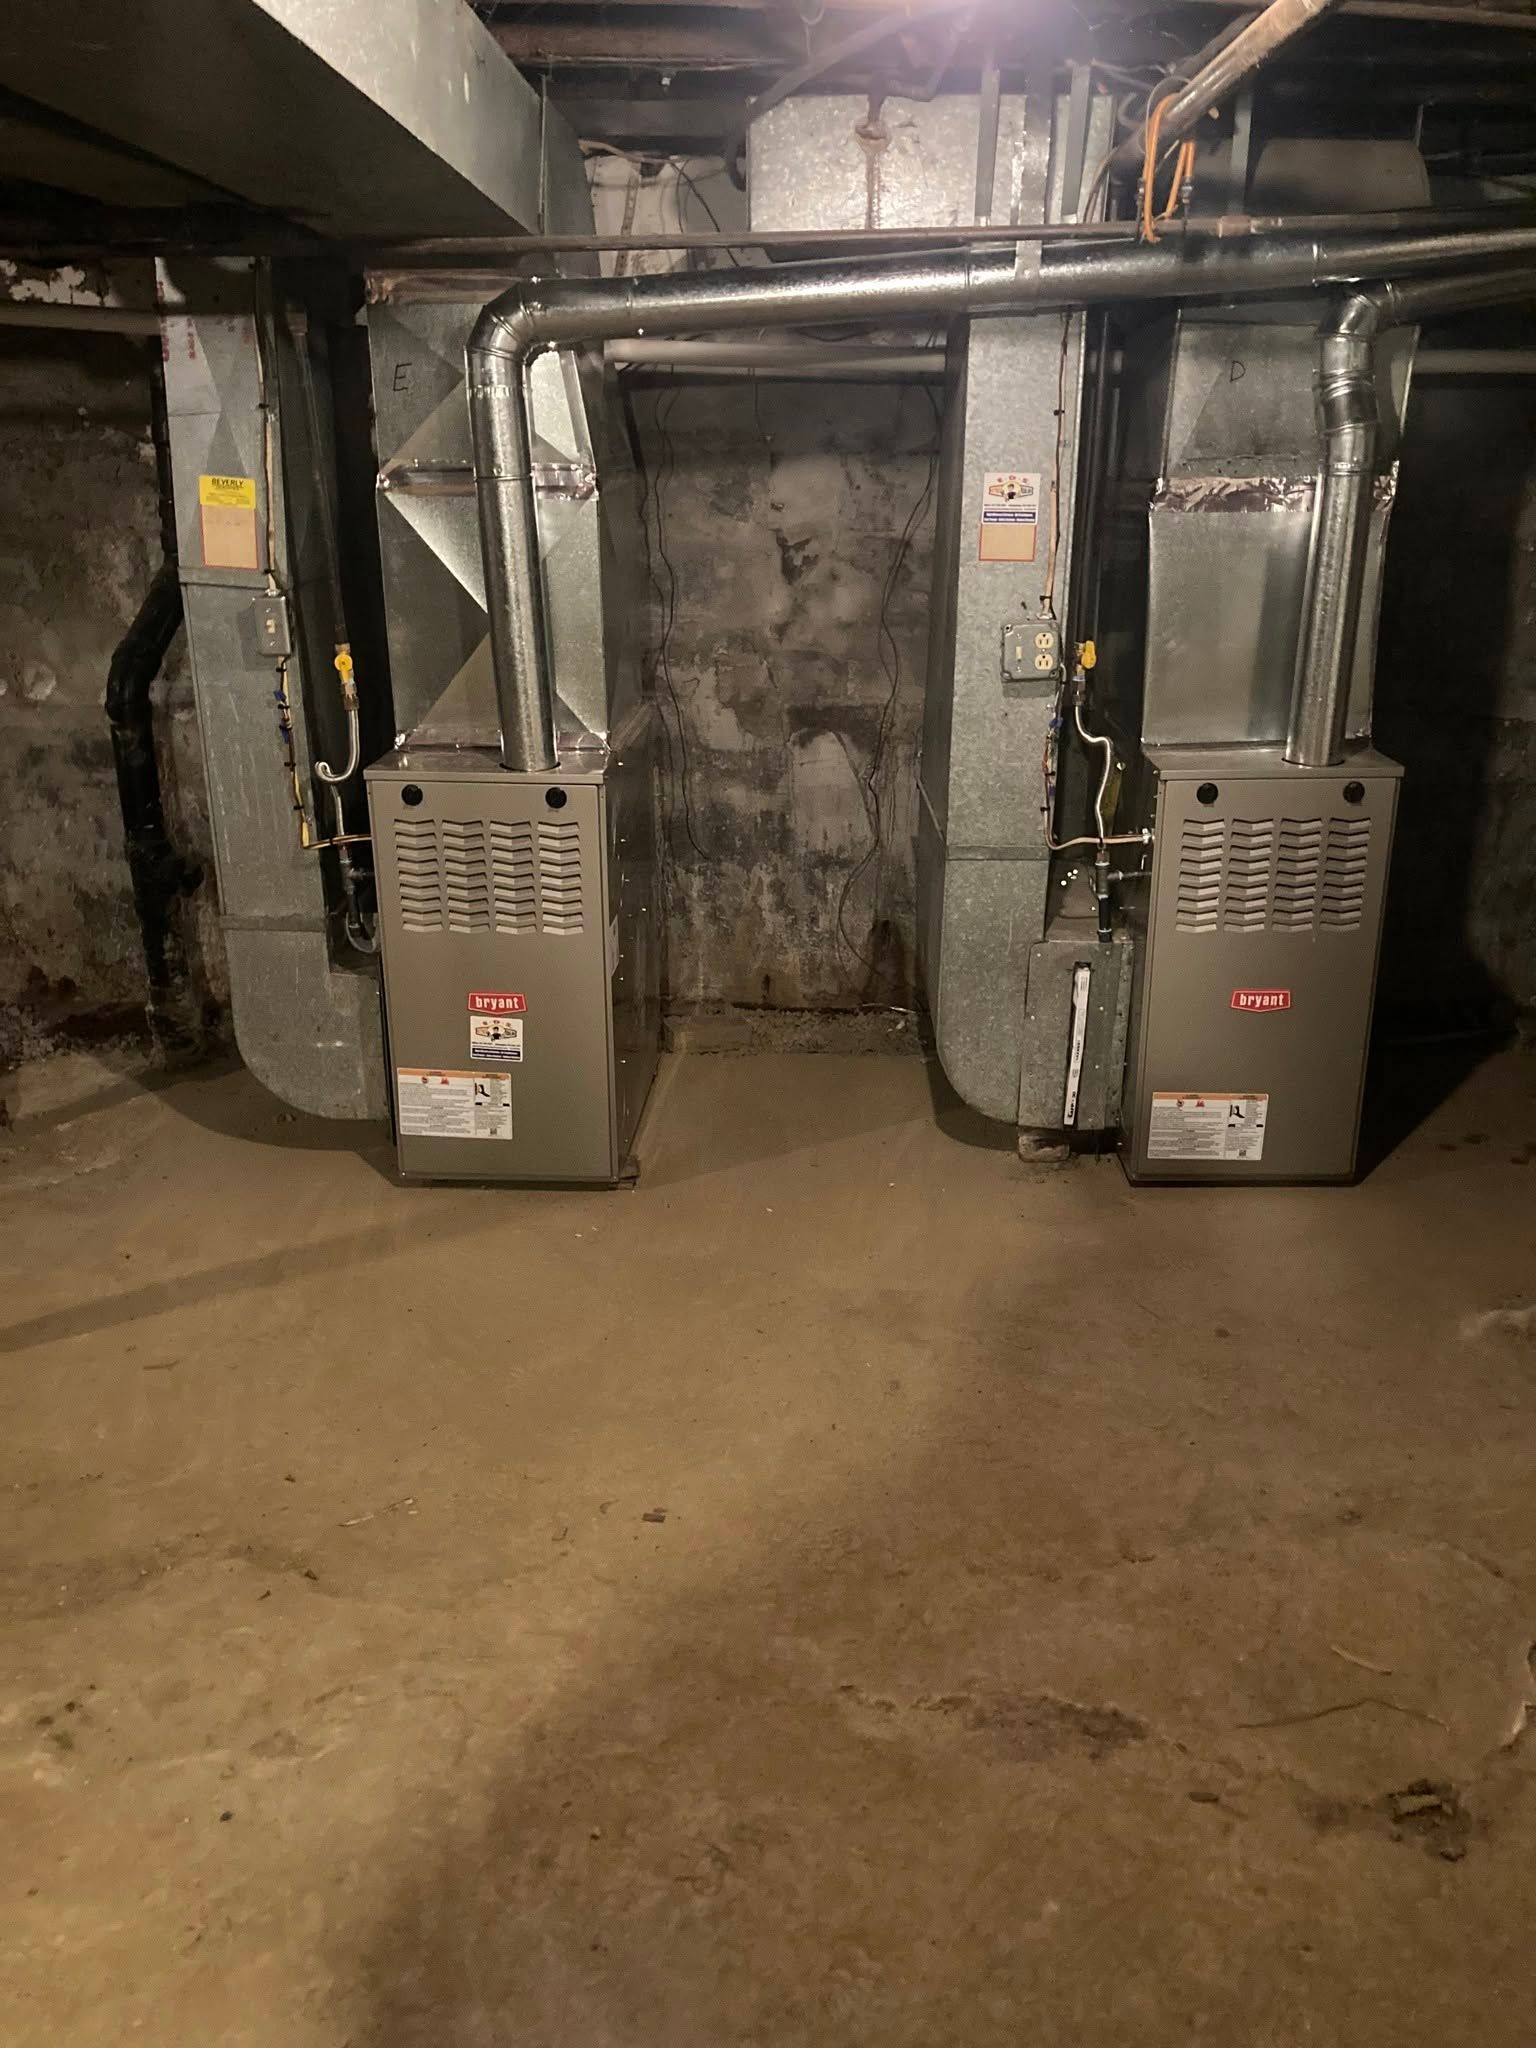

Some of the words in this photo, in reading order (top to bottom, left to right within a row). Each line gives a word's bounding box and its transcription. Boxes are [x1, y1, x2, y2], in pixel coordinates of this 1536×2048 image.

[393, 362, 412, 392] E
[1229, 360, 1246, 383] D
[211, 478, 244, 488] BEVERLY
[475, 995, 519, 1011] bryant
[1239, 993, 1284, 1008] bryant
